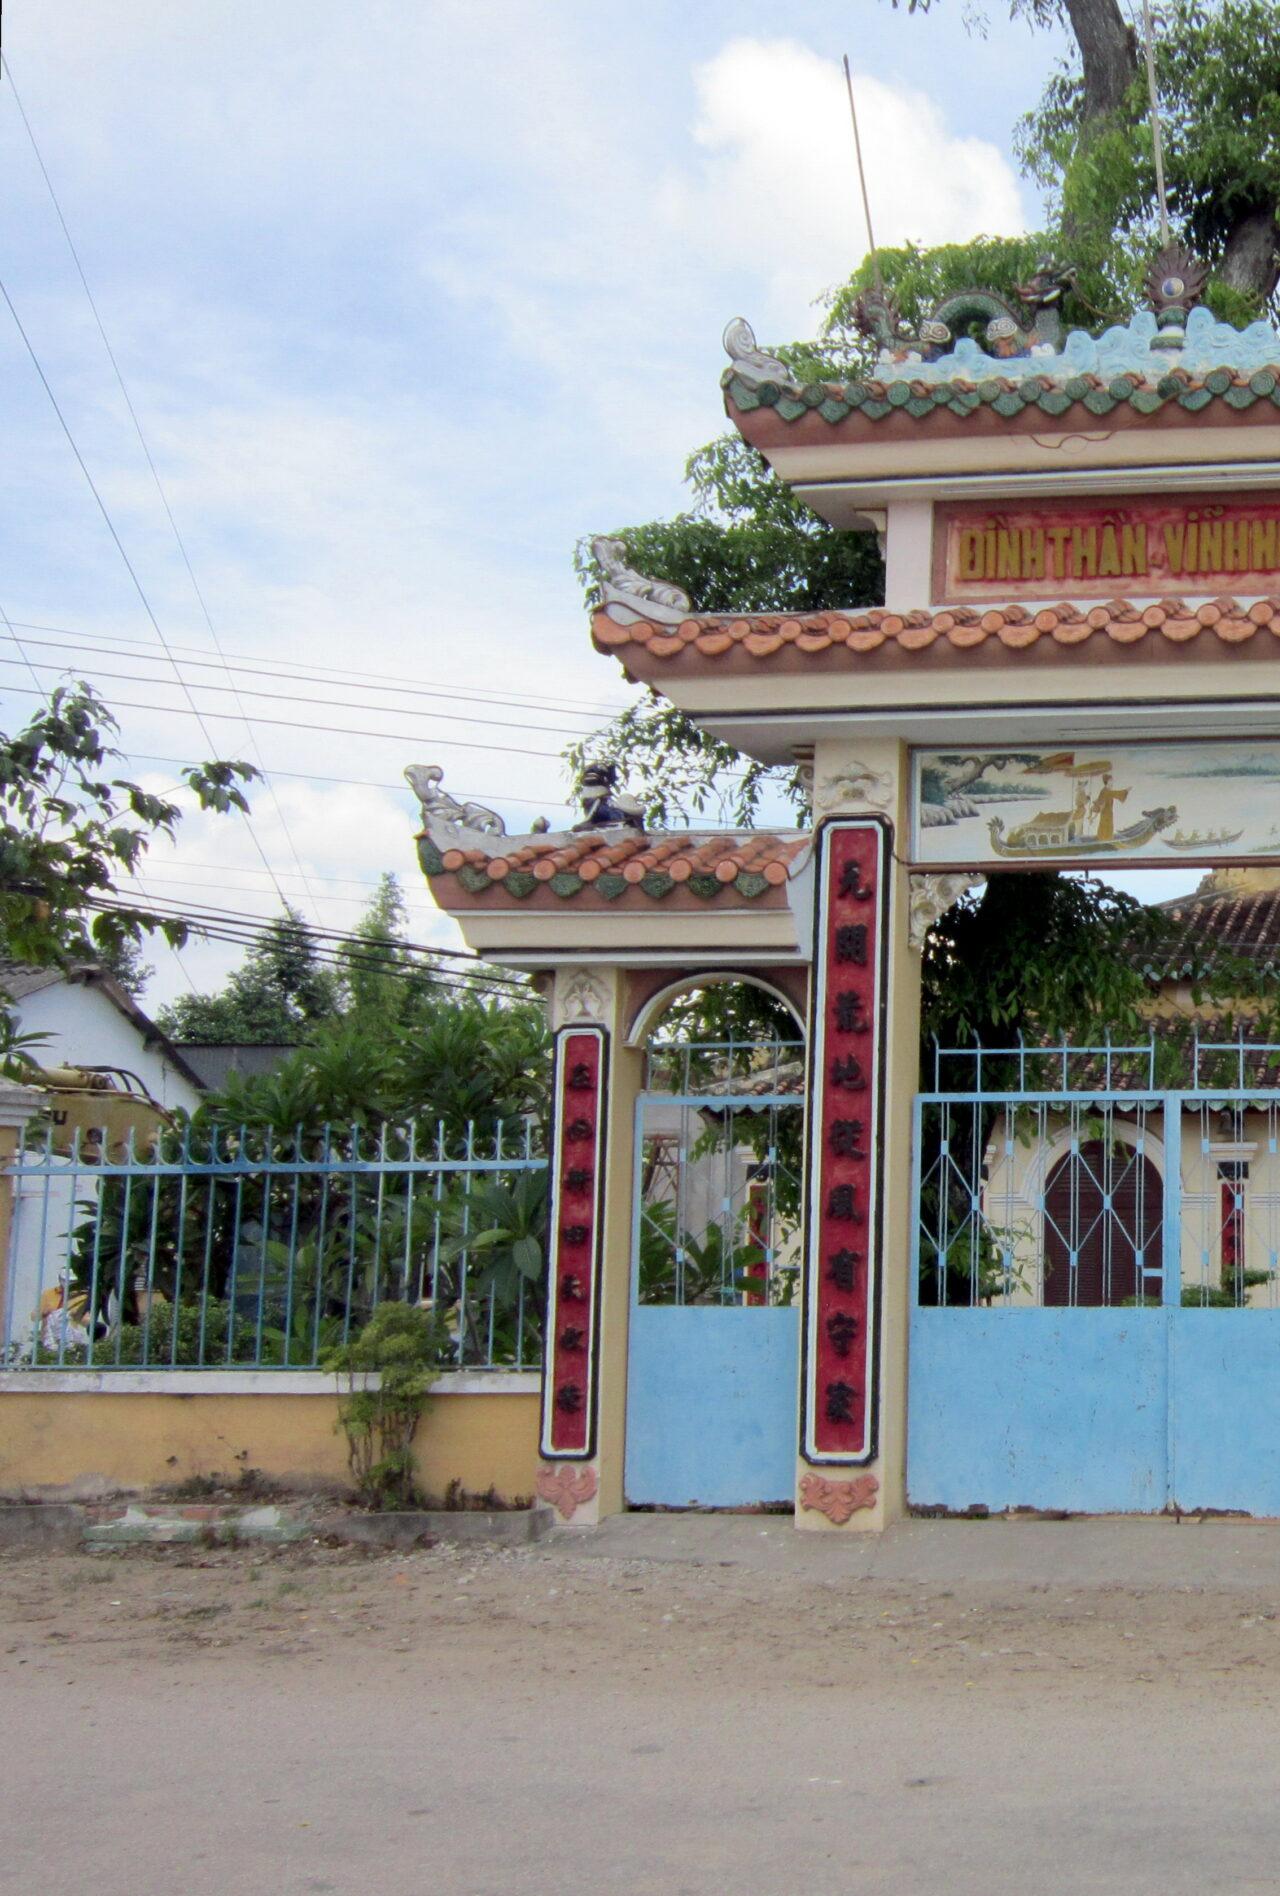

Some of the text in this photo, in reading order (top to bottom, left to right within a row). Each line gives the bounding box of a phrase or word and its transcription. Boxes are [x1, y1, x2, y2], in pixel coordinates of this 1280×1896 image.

[960, 514, 1046, 580] ĐÌNH
[1050, 511, 1147, 578] THẦN
[1163, 505, 1249, 573] VĨNH
